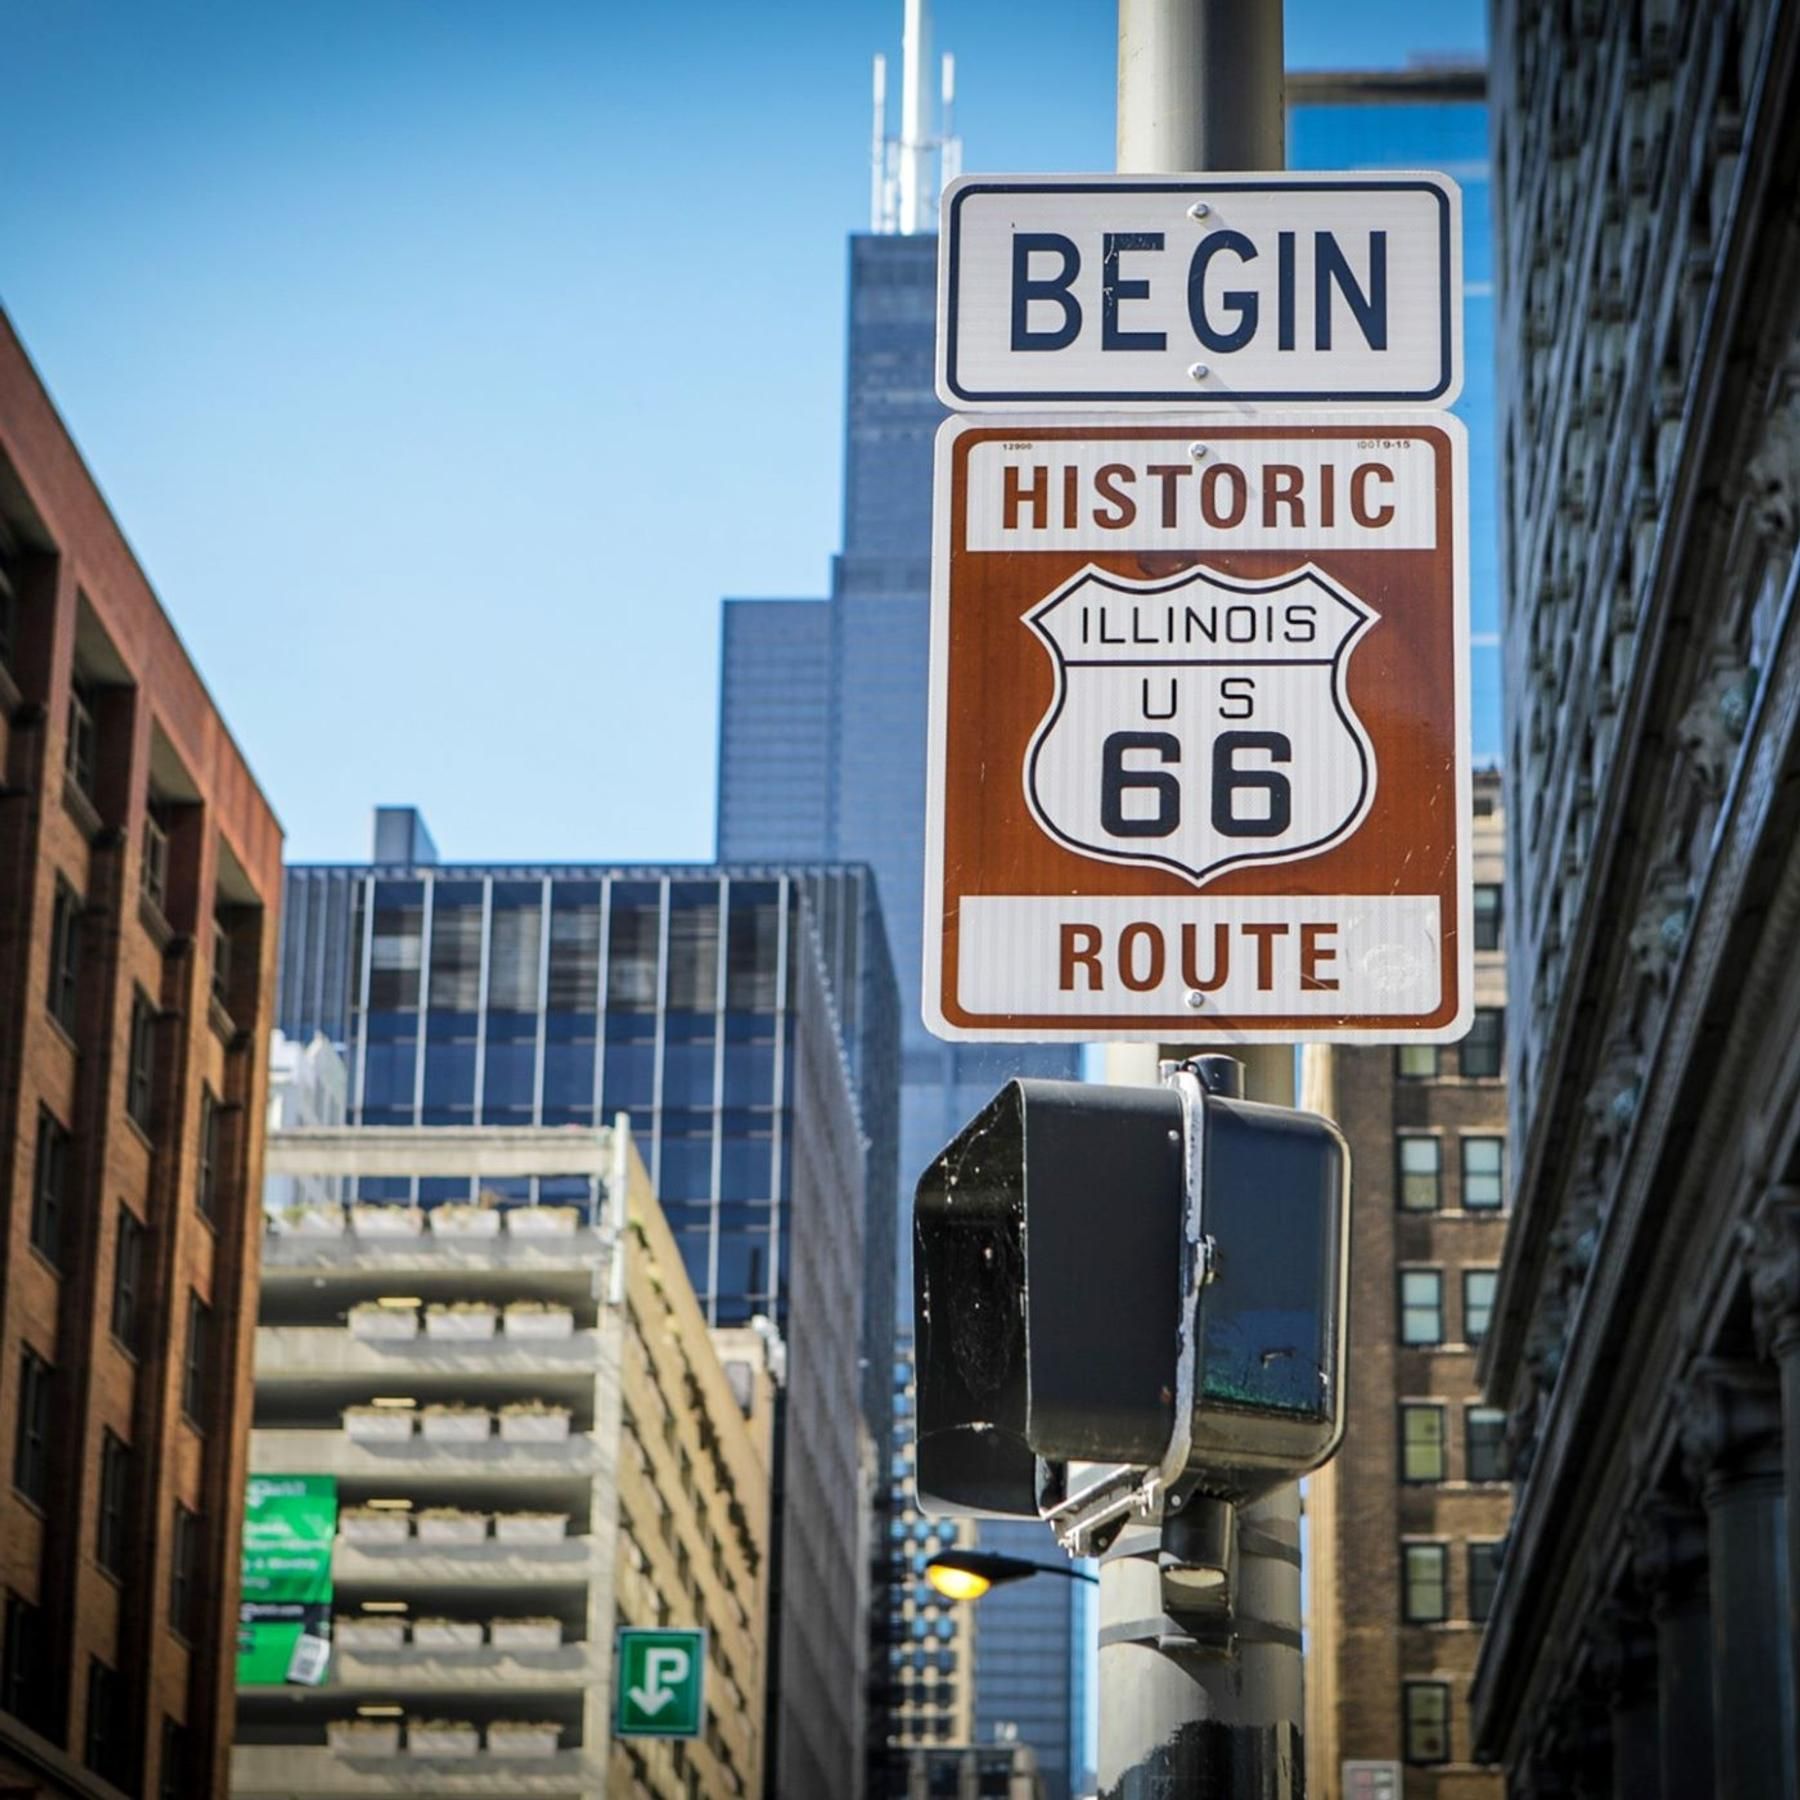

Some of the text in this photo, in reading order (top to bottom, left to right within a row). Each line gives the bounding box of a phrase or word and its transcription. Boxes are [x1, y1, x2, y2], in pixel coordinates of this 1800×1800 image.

[1011, 230, 1387, 353] BEGIN
[1003, 463, 1395, 530] HISTORIC
[1083, 606, 1316, 643] ILLINOIS
[1101, 731, 1291, 838] 66
[1059, 922, 1339, 992] ROUTE
